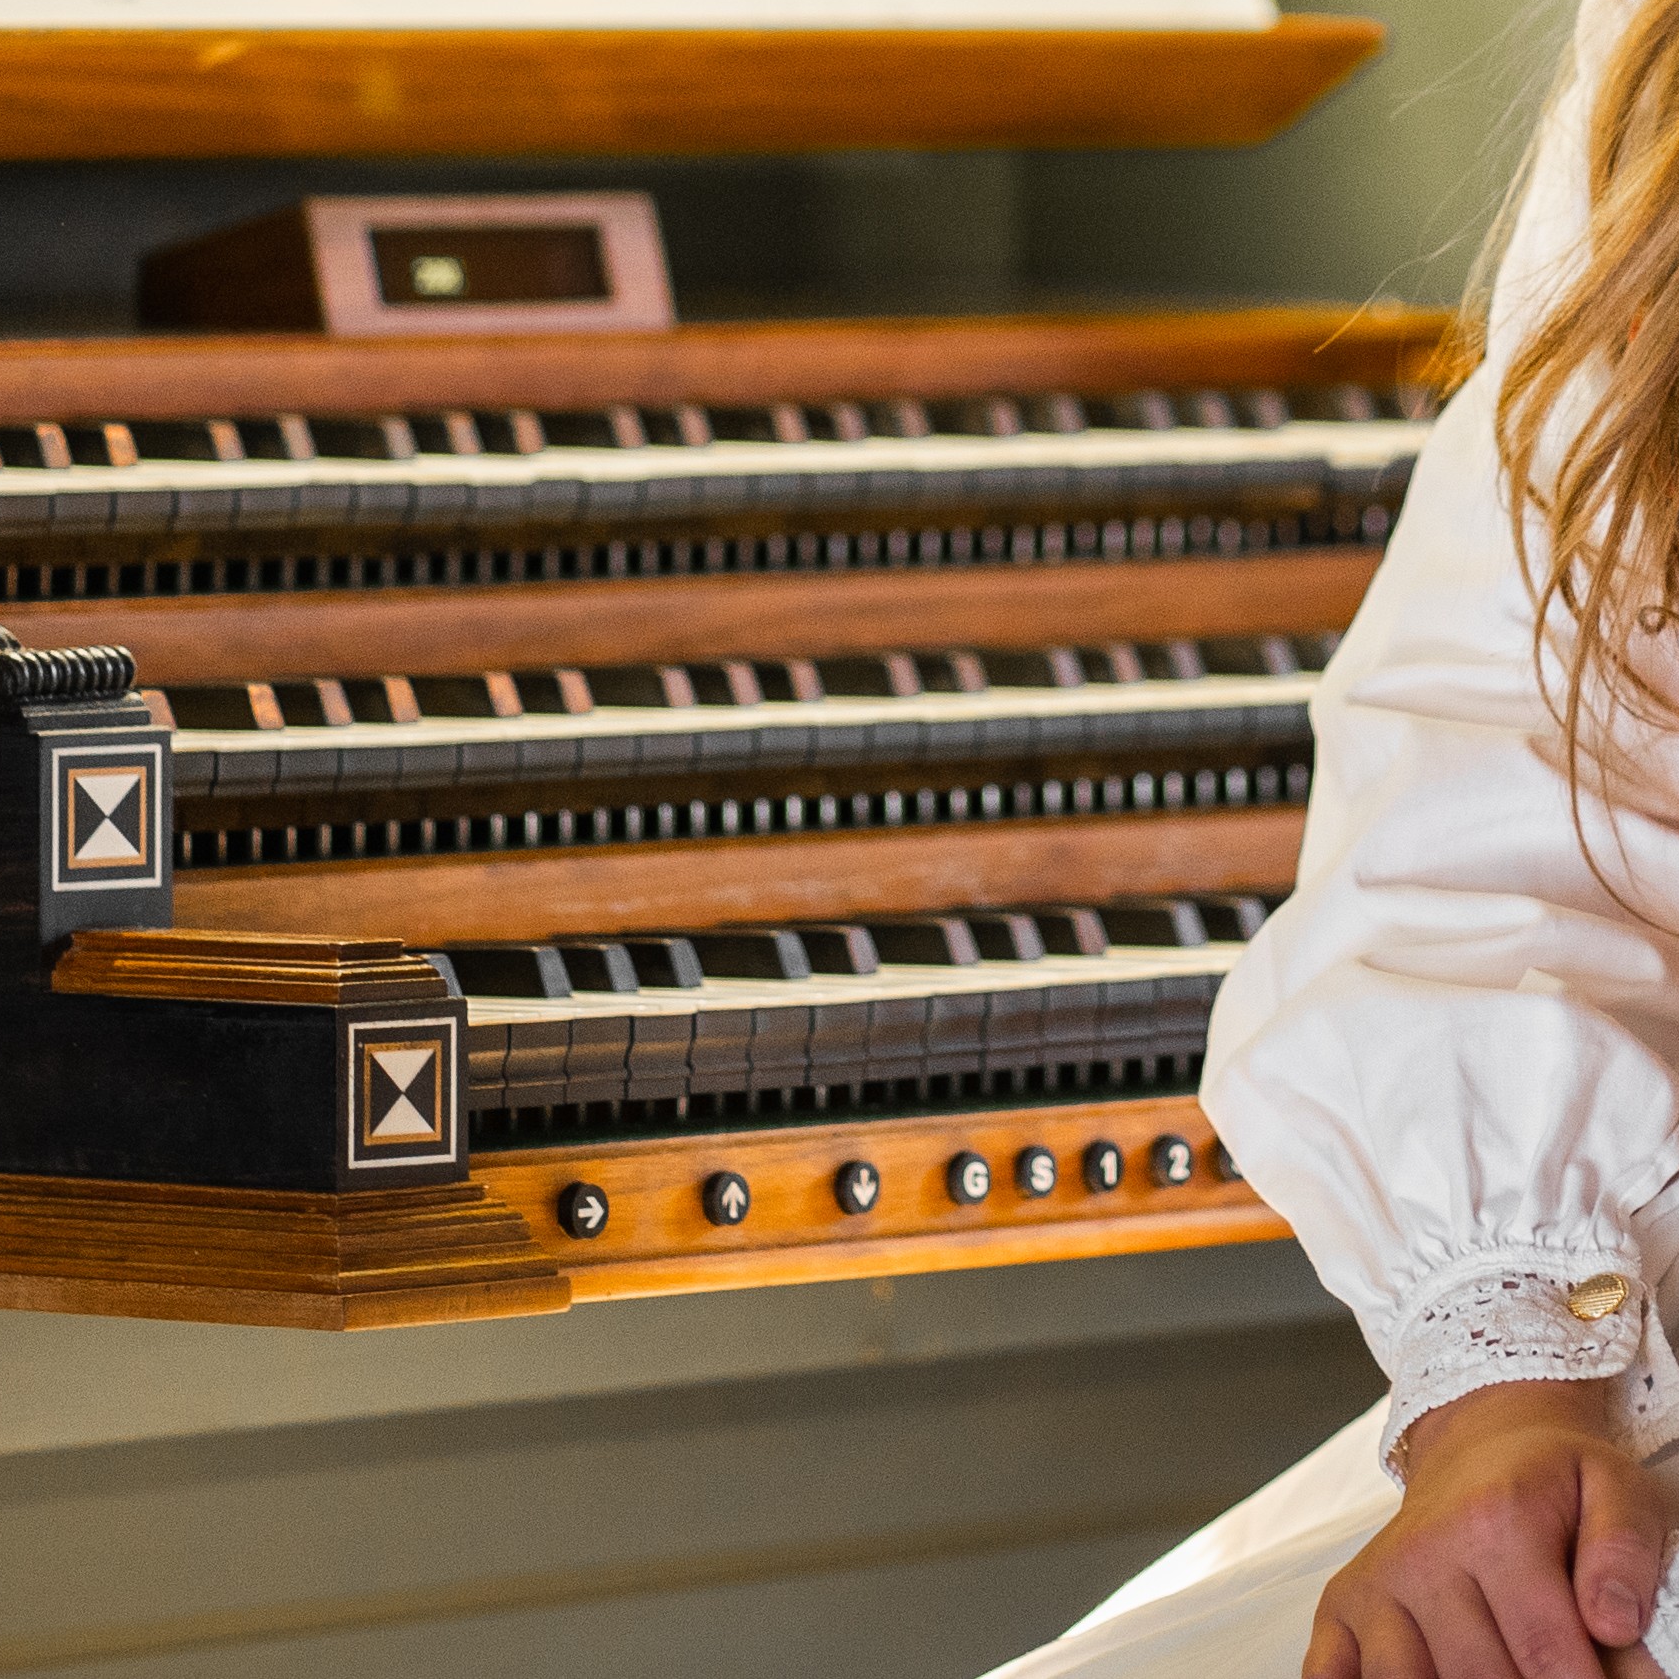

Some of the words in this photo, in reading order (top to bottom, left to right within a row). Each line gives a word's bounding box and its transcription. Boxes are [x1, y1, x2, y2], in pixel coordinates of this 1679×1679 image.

[963, 1161, 989, 1198] G
[1030, 1155, 1055, 1192] S
[1099, 1150, 1118, 1186] 1
[1168, 1143, 1191, 1181] 2
